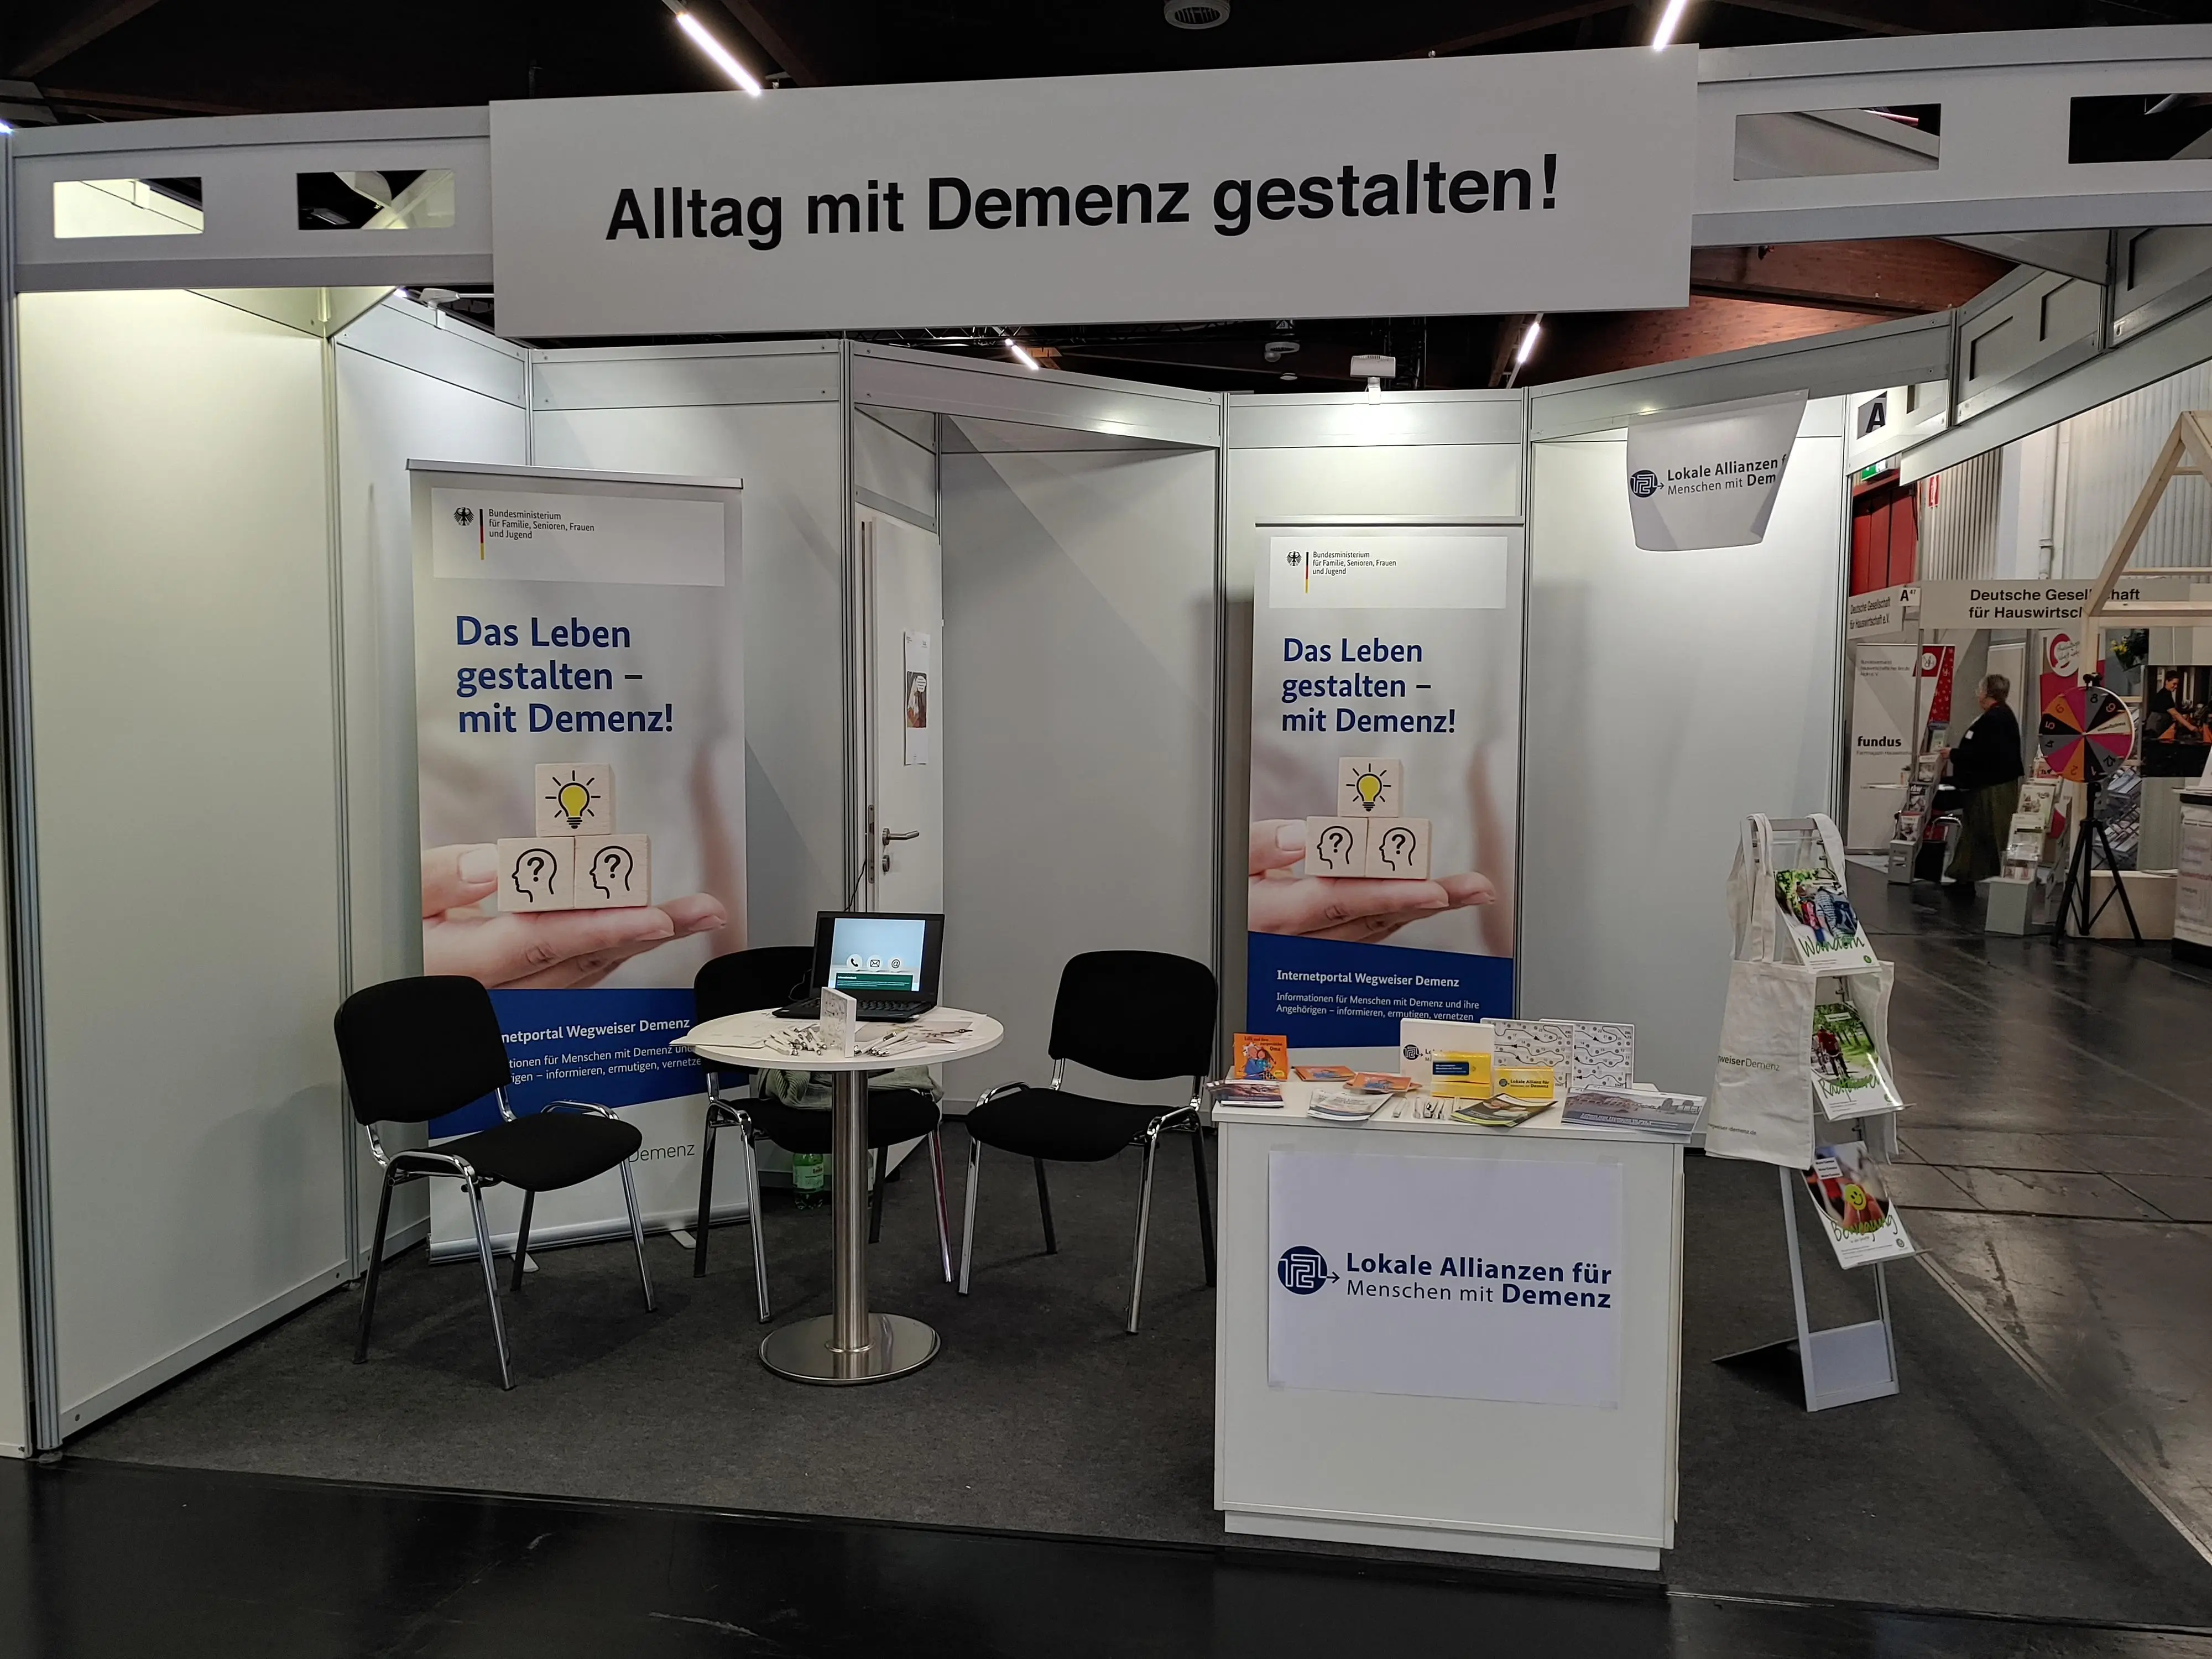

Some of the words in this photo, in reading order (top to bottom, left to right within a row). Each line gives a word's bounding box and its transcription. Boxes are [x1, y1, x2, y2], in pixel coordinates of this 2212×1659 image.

[606, 186, 782, 251] Alltag
[808, 180, 904, 234] mit
[929, 177, 1190, 231] Demenz
[1213, 153, 1557, 237] gestalten!
[1866, 403, 1886, 433] A
[1668, 465, 1711, 481] Lokale
[1715, 459, 1778, 477] Allianzen
[1668, 478, 1721, 495] Menschen
[1725, 478, 1743, 489] mit
[1747, 472, 1776, 487] Dem
[489, 509, 561, 521] Bundesministerium
[489, 519, 499, 529] für
[502, 519, 531, 532] Familie,
[533, 521, 568, 531] Senioren,
[570, 523, 594, 531] Frauen
[489, 529, 504, 538] und
[505, 530, 532, 540] Jugend
[1312, 551, 1370, 559] Bundesministerium
[1323, 559, 1347, 570] Familie,
[1347, 559, 1375, 567] Senioren,
[1325, 567, 1346, 576] Jugend
[1900, 589, 1909, 602] A
[1970, 589, 2041, 601] Deutsche
[1969, 606, 1990, 618] für
[456, 615, 519, 646] Das
[531, 617, 630, 648] Leben
[1284, 638, 1331, 662] Das
[1342, 637, 1422, 662] Leben
[457, 659, 612, 698] gestalten
[1281, 672, 1405, 703] gestalten
[2090, 693, 2098, 703] 8
[459, 702, 517, 733] mit
[529, 703, 672, 733] Demenz!
[1282, 707, 1327, 732] mit
[1336, 708, 1455, 733] Demenz!
[2044, 721, 2055, 730] 5
[1858, 735, 1902, 747] fundus
[1277, 970, 1352, 984] Internetportal
[1354, 973, 1413, 987] Wegweiser
[1416, 975, 1459, 987] Demenz
[1276, 992, 1333, 1003] Informationen
[1335, 994, 1348, 1004] für
[1350, 995, 1391, 1005] Menschen
[1393, 997, 1407, 1006] mit
[1410, 998, 1443, 1008] Demenz
[1445, 999, 1461, 1009] und
[1464, 1000, 1479, 1009] ihre
[1276, 1004, 1327, 1016] Angehörigen
[1337, 1006, 1385, 1018] informieren,
[1387, 1008, 1432, 1020] ermutigen,
[1433, 1011, 1473, 1021] vernetzen
[502, 1026, 563, 1044] netportal
[566, 1022, 636, 1039] Wegweiser
[639, 1019, 690, 1032] Demenz
[544, 1055, 559, 1065] für
[562, 1051, 611, 1063] Menschen
[614, 1048, 631, 1058] mit
[634, 1045, 674, 1057] Demenz
[546, 1067, 606, 1079] informieren,
[608, 1061, 659, 1073] ermutigen,
[1347, 1253, 1432, 1276] Lokale
[1439, 1256, 1563, 1282] Allianzen
[1572, 1262, 1611, 1284] für
[1347, 1280, 1451, 1301] Menschen
[1460, 1286, 1494, 1303] mit
[1503, 1282, 1611, 1308] Demenz
